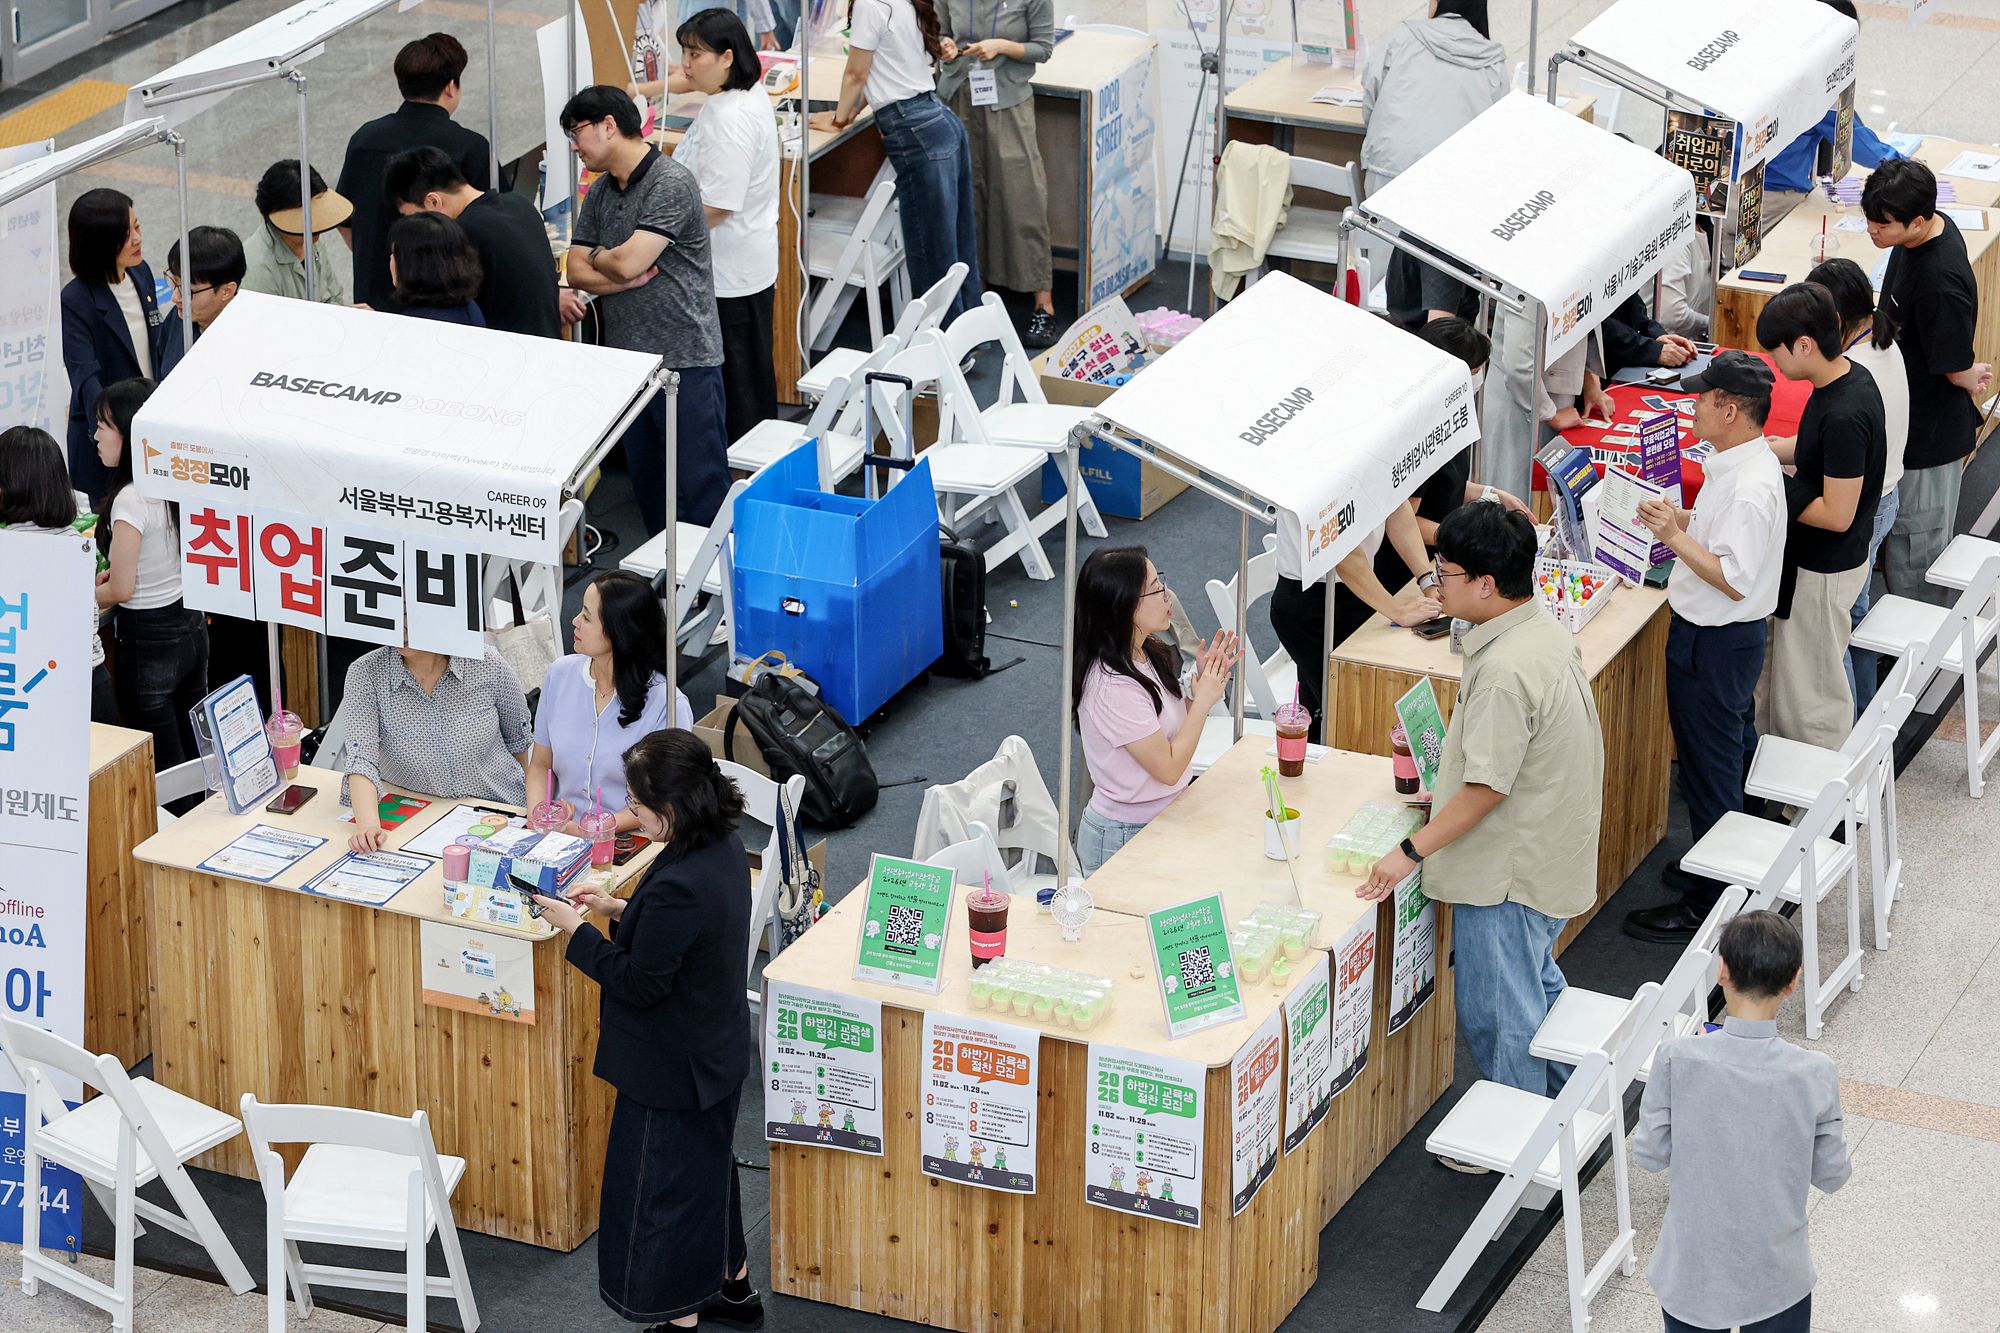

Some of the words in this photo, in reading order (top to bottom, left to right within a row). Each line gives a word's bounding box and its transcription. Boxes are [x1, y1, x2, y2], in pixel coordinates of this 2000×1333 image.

[1686, 29, 1740, 72] BASECAMP
[974, 85, 993, 94] STAFF
[1095, 114, 1123, 162] STREET
[1675, 133, 1721, 158] 취업과
[1754, 117, 1779, 155] 청정모아
[1674, 152, 1719, 176] 타로의
[1672, 192, 1688, 212] CAREER
[1743, 182, 1760, 206] 취업과
[1490, 189, 1557, 242] BASECAMP
[1743, 202, 1761, 227] 타로의
[1745, 221, 1757, 243] 만남
[1602, 269, 1624, 300] 서울시
[1624, 236, 1658, 280] 기술교육원
[1659, 210, 1692, 250] 북부캠퍼스
[1562, 292, 1593, 336] 청정모아
[1080, 327, 1099, 344] 년생
[1089, 332, 1114, 353] 청년
[1085, 359, 1098, 372] 첫
[1096, 344, 1121, 364] 출발
[1085, 362, 1116, 383] 원금
[250, 371, 402, 406] BASECAMP
[397, 395, 526, 427] DOBONG
[1444, 388, 1462, 409] CAREER
[1460, 381, 1468, 395] 10
[1238, 386, 1315, 446] BASECAMP
[1391, 419, 1452, 489] 청년취업사관학교
[1453, 403, 1469, 429] 도봉
[1642, 425, 1676, 447] 무료직업교육
[1663, 437, 1675, 449] 모집
[170, 441, 189, 451] 출발은
[190, 444, 214, 455] 도봉에서
[152, 468, 169, 478] 제3회
[170, 455, 250, 491] 청정모아
[487, 490, 531, 507] CAREER
[532, 497, 547, 509] 09
[339, 486, 546, 541] 서울북부고용복지+센터
[1320, 499, 1355, 550] 청정모아
[0, 787, 80, 823] 원제도
[882, 865, 941, 884] 청년취업사관학교
[882, 876, 907, 887] 2026년
[908, 880, 927, 890] 교육생
[928, 883, 940, 894] 모집
[907, 895, 918, 903] 선물
[1399, 898, 1407, 917] 20
[1159, 906, 1212, 928] 청년취업사관학교
[1162, 924, 1184, 936] 2026년
[1186, 919, 1201, 930] 교육생
[1202, 915, 1214, 925] 모집
[1399, 913, 1408, 933] 26
[1339, 960, 1348, 980] 20
[5, 967, 52, 1018] 아
[1339, 978, 1347, 995] 26
[777, 1007, 798, 1025] 20
[1291, 1015, 1301, 1036] 20
[777, 1023, 798, 1040] 26
[805, 1016, 837, 1030] 하반기
[840, 1021, 871, 1039] 교육생
[816, 1028, 838, 1042] 절찬
[840, 1032, 860, 1047] 모집
[777, 1046, 795, 1055] 11.02
[808, 1050, 826, 1060] 11.29
[933, 1039, 954, 1056] 20
[1292, 1034, 1301, 1051] 26
[932, 1055, 954, 1072] 26
[961, 1047, 993, 1063] 하반기
[995, 1053, 1028, 1070] 교육생
[1250, 1056, 1264, 1079] 하반기
[1264, 1040, 1279, 1066] 교육생
[1264, 1056, 1275, 1075] 모집
[971, 1060, 993, 1075] 절찬
[995, 1064, 1016, 1080] 모집
[1098, 1071, 1120, 1087] 20
[932, 1079, 949, 1088] 11.02
[963, 1084, 980, 1094] 11.29
[1127, 1079, 1159, 1095] 하반기
[1161, 1086, 1194, 1103] 교육생
[1237, 1070, 1249, 1092] 20
[1098, 1086, 1119, 1104] 26
[1137, 1091, 1159, 1107] 절찬
[1161, 1097, 1183, 1112] 모집
[1237, 1090, 1249, 1107] 26
[1252, 1097, 1261, 1108] 11.29
[1098, 1110, 1115, 1119] 11.02
[1129, 1115, 1147, 1125] 11.29
